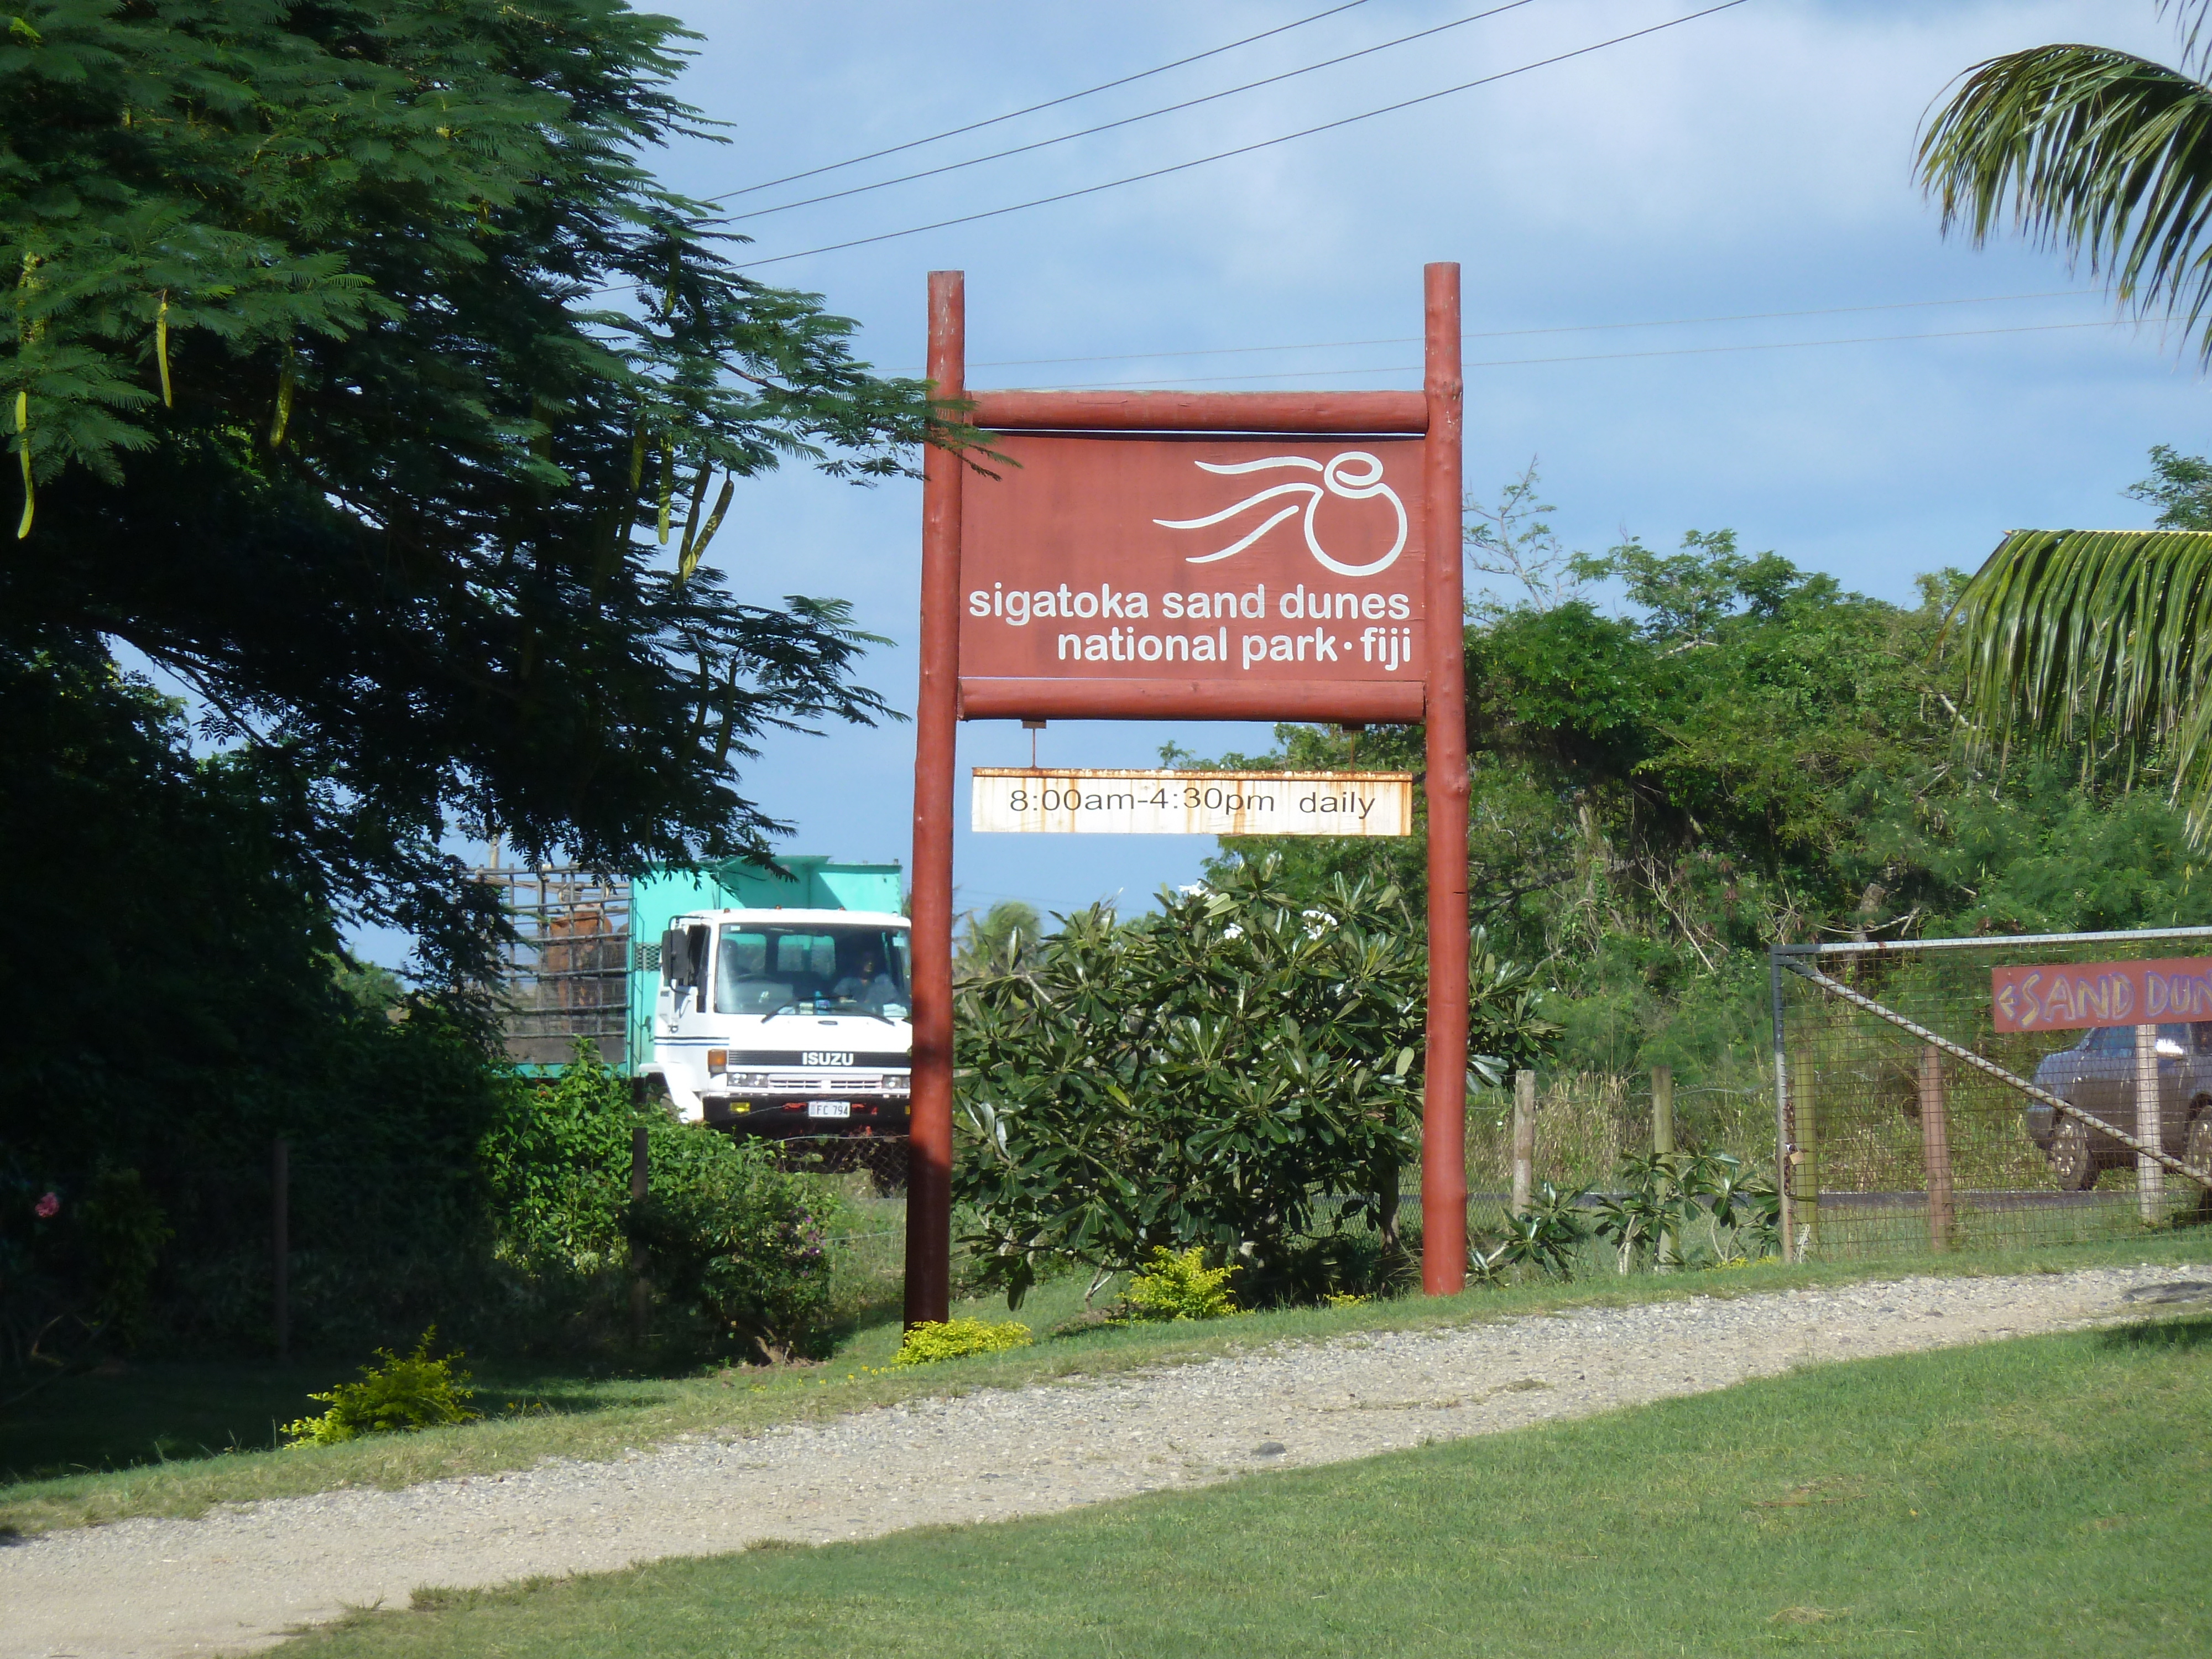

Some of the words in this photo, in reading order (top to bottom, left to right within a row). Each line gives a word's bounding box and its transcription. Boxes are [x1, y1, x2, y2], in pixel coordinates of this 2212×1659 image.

[969, 582, 1149, 625] sigatoka
[1162, 584, 1265, 618] sand
[1280, 584, 1410, 619] dunes
[1058, 626, 1227, 661] national
[1010, 787, 1274, 815] 8:00am-4:30pm
[1299, 791, 1376, 819] daily
[2018, 970, 2135, 1027] SAND
[802, 1052, 854, 1066] ISUZU
